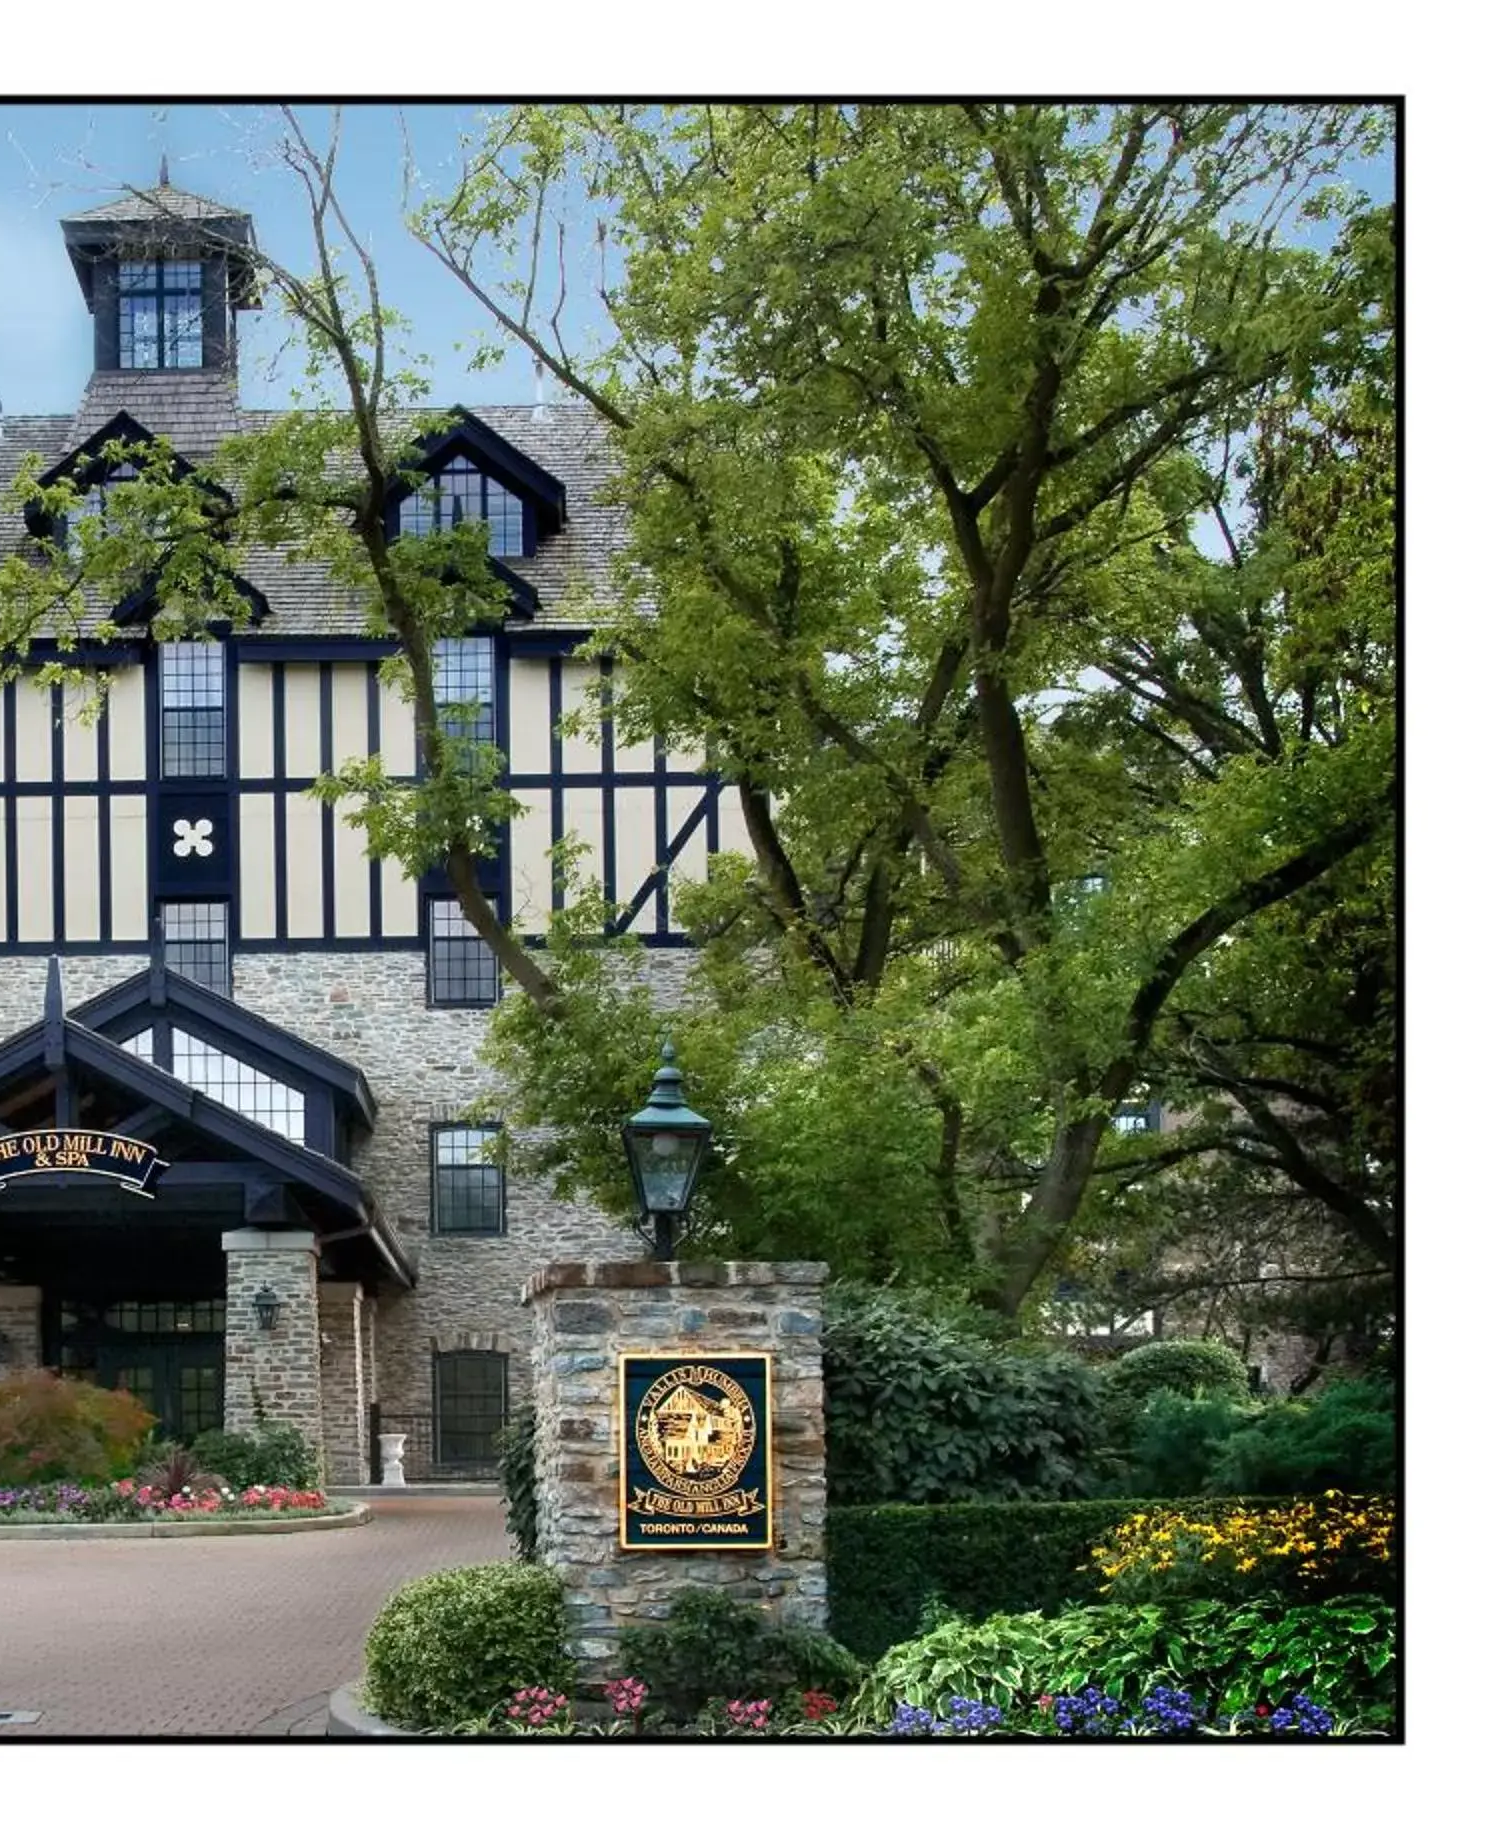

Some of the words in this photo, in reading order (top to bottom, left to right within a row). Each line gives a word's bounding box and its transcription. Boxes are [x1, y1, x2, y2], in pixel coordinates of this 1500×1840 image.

[22, 1135, 59, 1154] OLD
[63, 1134, 108, 1156] MILL
[109, 1140, 147, 1165] INN
[34, 1151, 50, 1168] &
[55, 1151, 90, 1167] SPA
[651, 1493, 671, 1511] THE
[673, 1499, 694, 1513] OLD
[696, 1499, 722, 1513] MILL
[723, 1494, 741, 1511] INN
